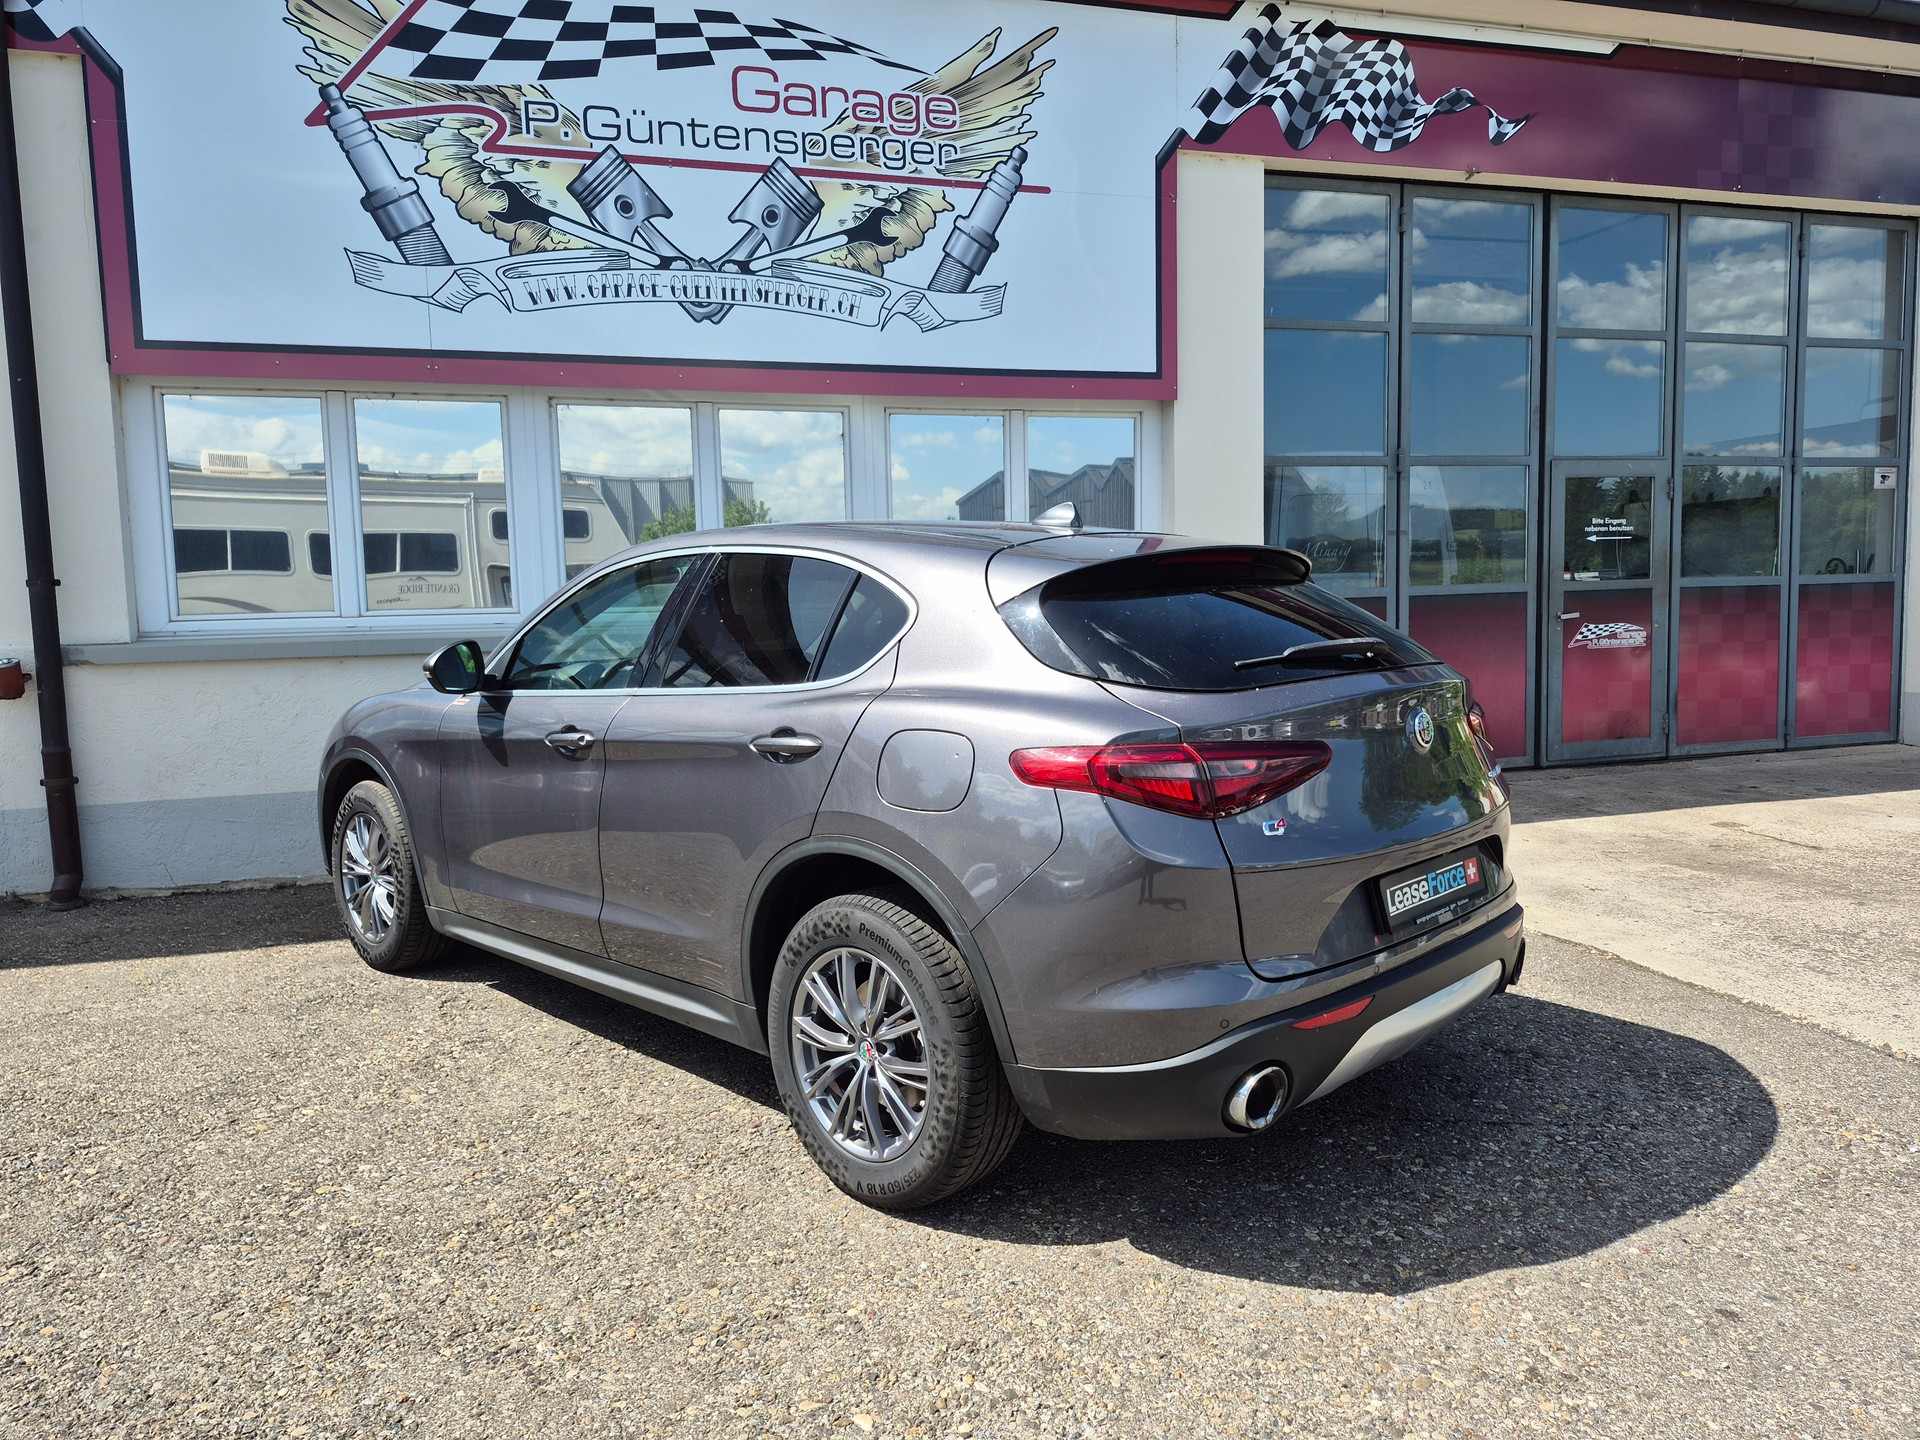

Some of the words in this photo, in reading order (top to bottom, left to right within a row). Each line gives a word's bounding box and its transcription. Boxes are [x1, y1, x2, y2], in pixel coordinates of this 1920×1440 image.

[731, 65, 958, 136] Garage
[583, 104, 959, 168] Güntensperger
[522, 272, 862, 319] WWW.GARAGE-GUENTENSPERGER.CH
[1386, 866, 1466, 914] LeaseForce
[859, 922, 934, 1014] PremiumContact
